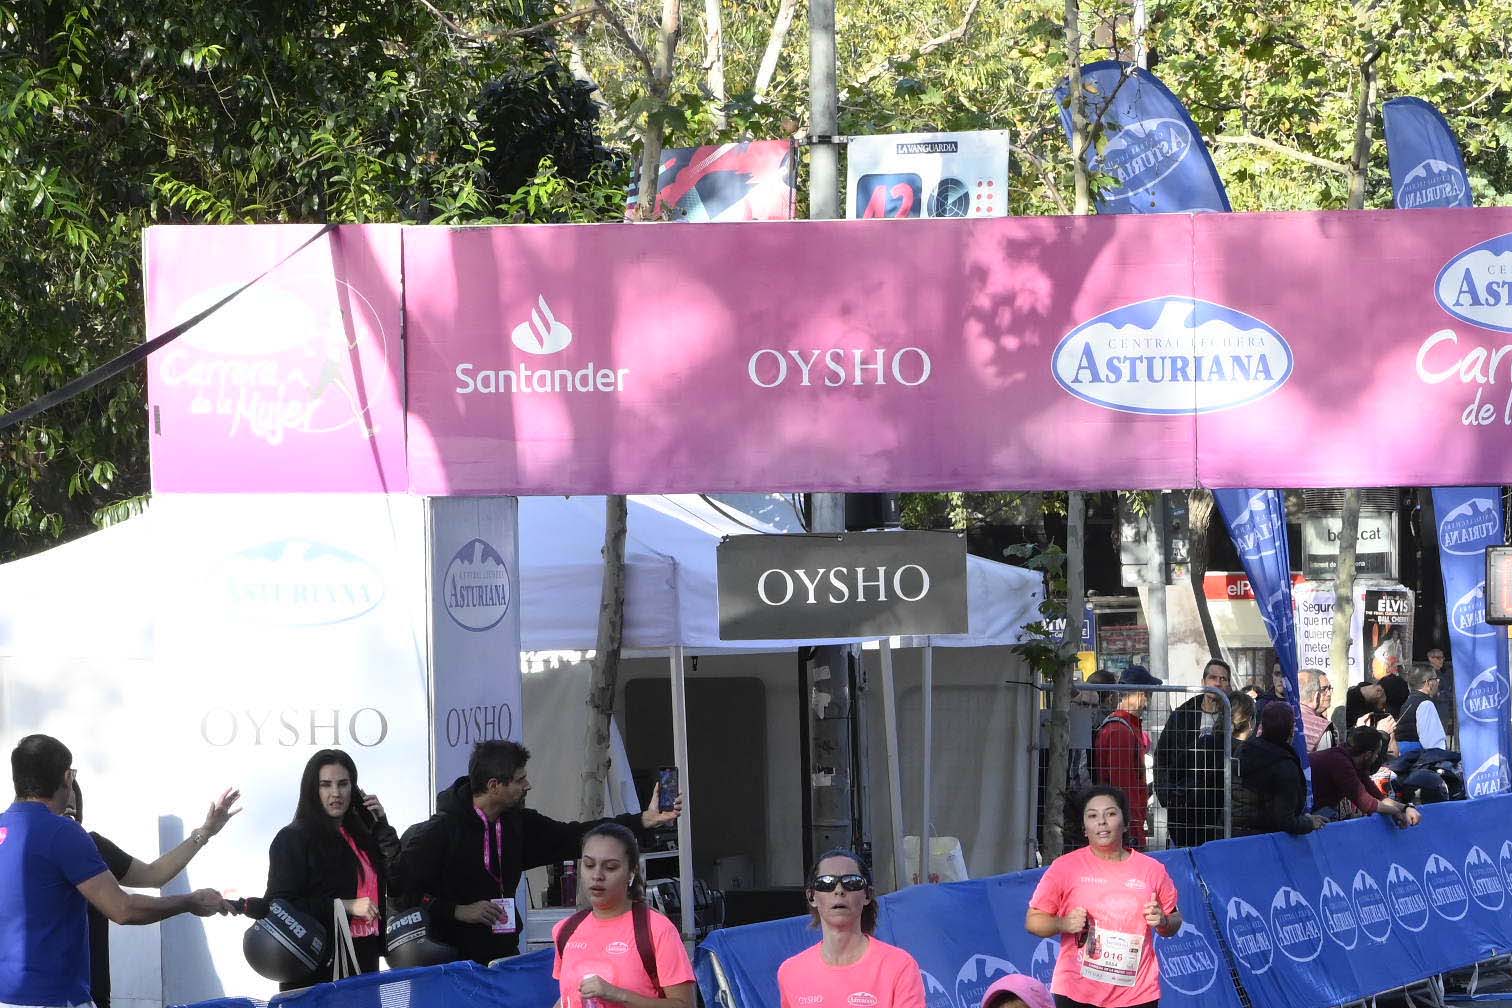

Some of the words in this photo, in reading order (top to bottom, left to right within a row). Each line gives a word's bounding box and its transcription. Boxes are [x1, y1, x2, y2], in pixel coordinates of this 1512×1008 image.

[455, 362, 630, 395] Santander
[747, 347, 932, 388] OYSHO
[1071, 341, 1276, 384] ASTURIANA
[1461, 388, 1496, 427] de
[447, 574, 507, 609] ASTURIANA
[757, 564, 931, 606] OYSHO
[1377, 599, 1409, 613] ELVIS
[200, 706, 388, 747] OYSHO
[1103, 951, 1123, 962] 016
